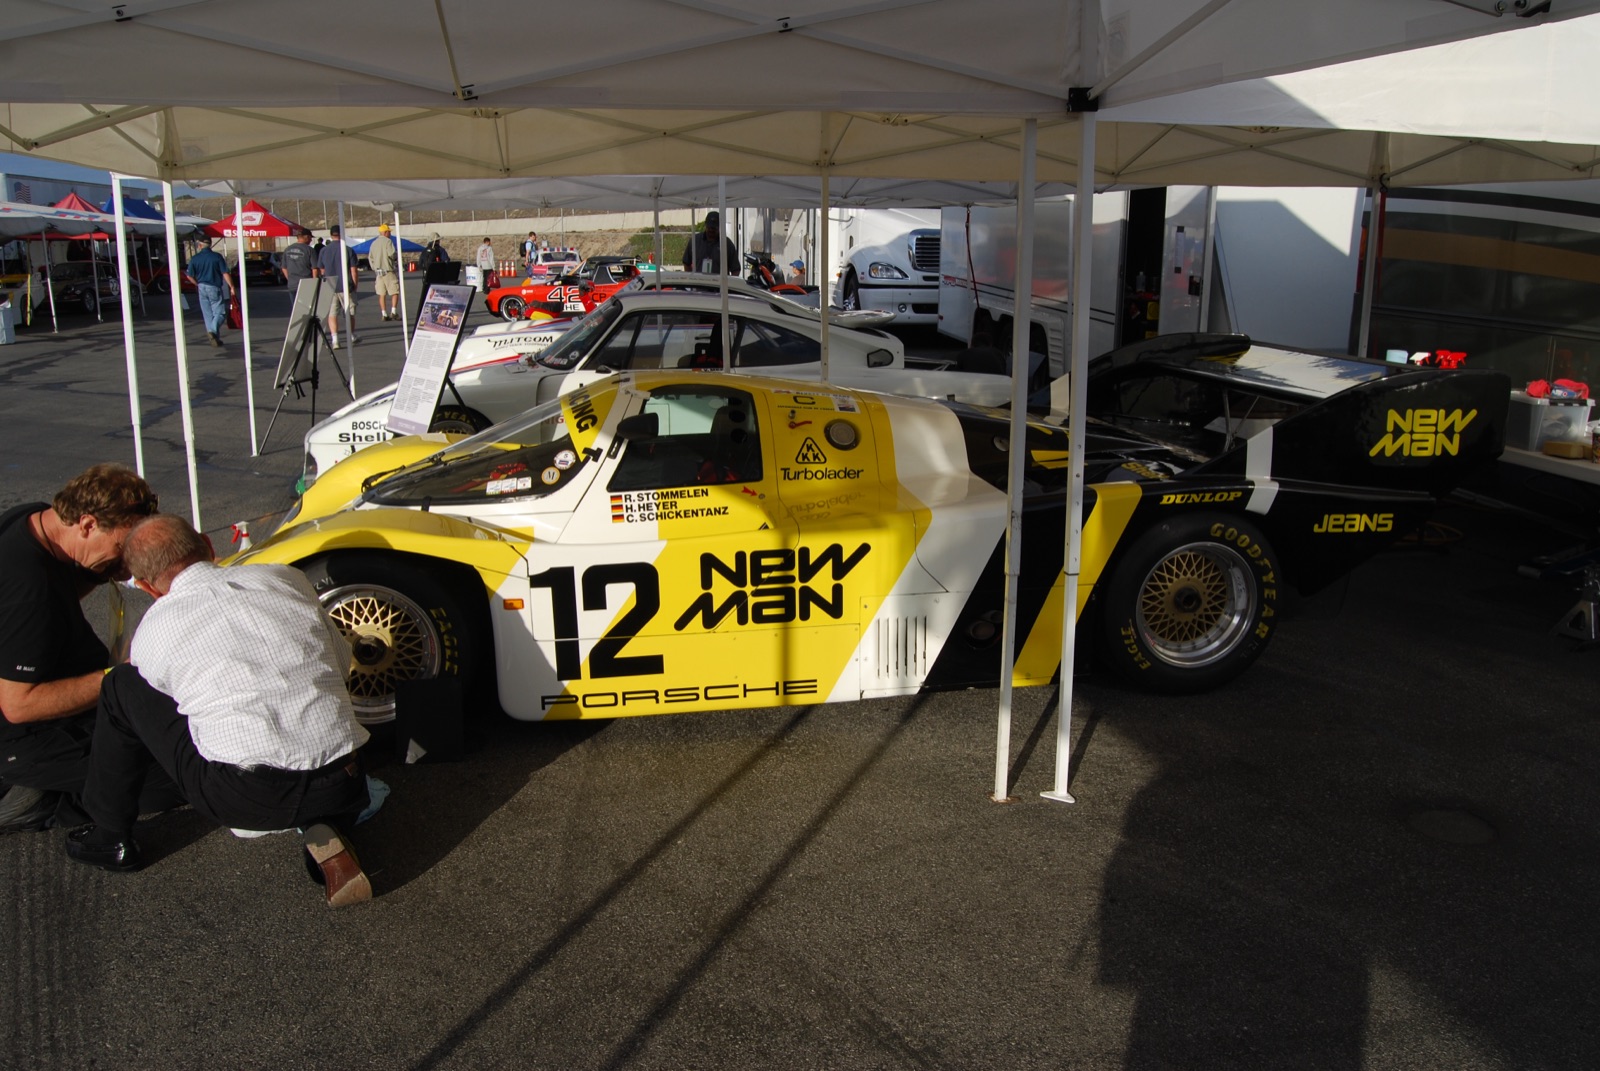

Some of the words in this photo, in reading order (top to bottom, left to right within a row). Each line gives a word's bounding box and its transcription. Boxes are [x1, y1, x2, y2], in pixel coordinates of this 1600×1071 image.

[232, 229, 250, 237] Ste
[547, 286, 580, 304] 42
[592, 293, 607, 302] CP
[338, 432, 387, 443] Shell
[780, 467, 864, 481] Turbolader
[637, 488, 709, 502] STOMMELEN
[1160, 491, 1243, 505] DUNLOP
[637, 500, 678, 512] HEYER
[639, 506, 729, 522] SCHICKENTANZ
[1313, 513, 1394, 533] JEANS
[1210, 522, 1277, 640] GOODYEAR
[530, 562, 664, 682] 12
[429, 607, 459, 676] EAGLE
[1120, 626, 1152, 671] EAGLE
[540, 678, 818, 711] PORSCHE
